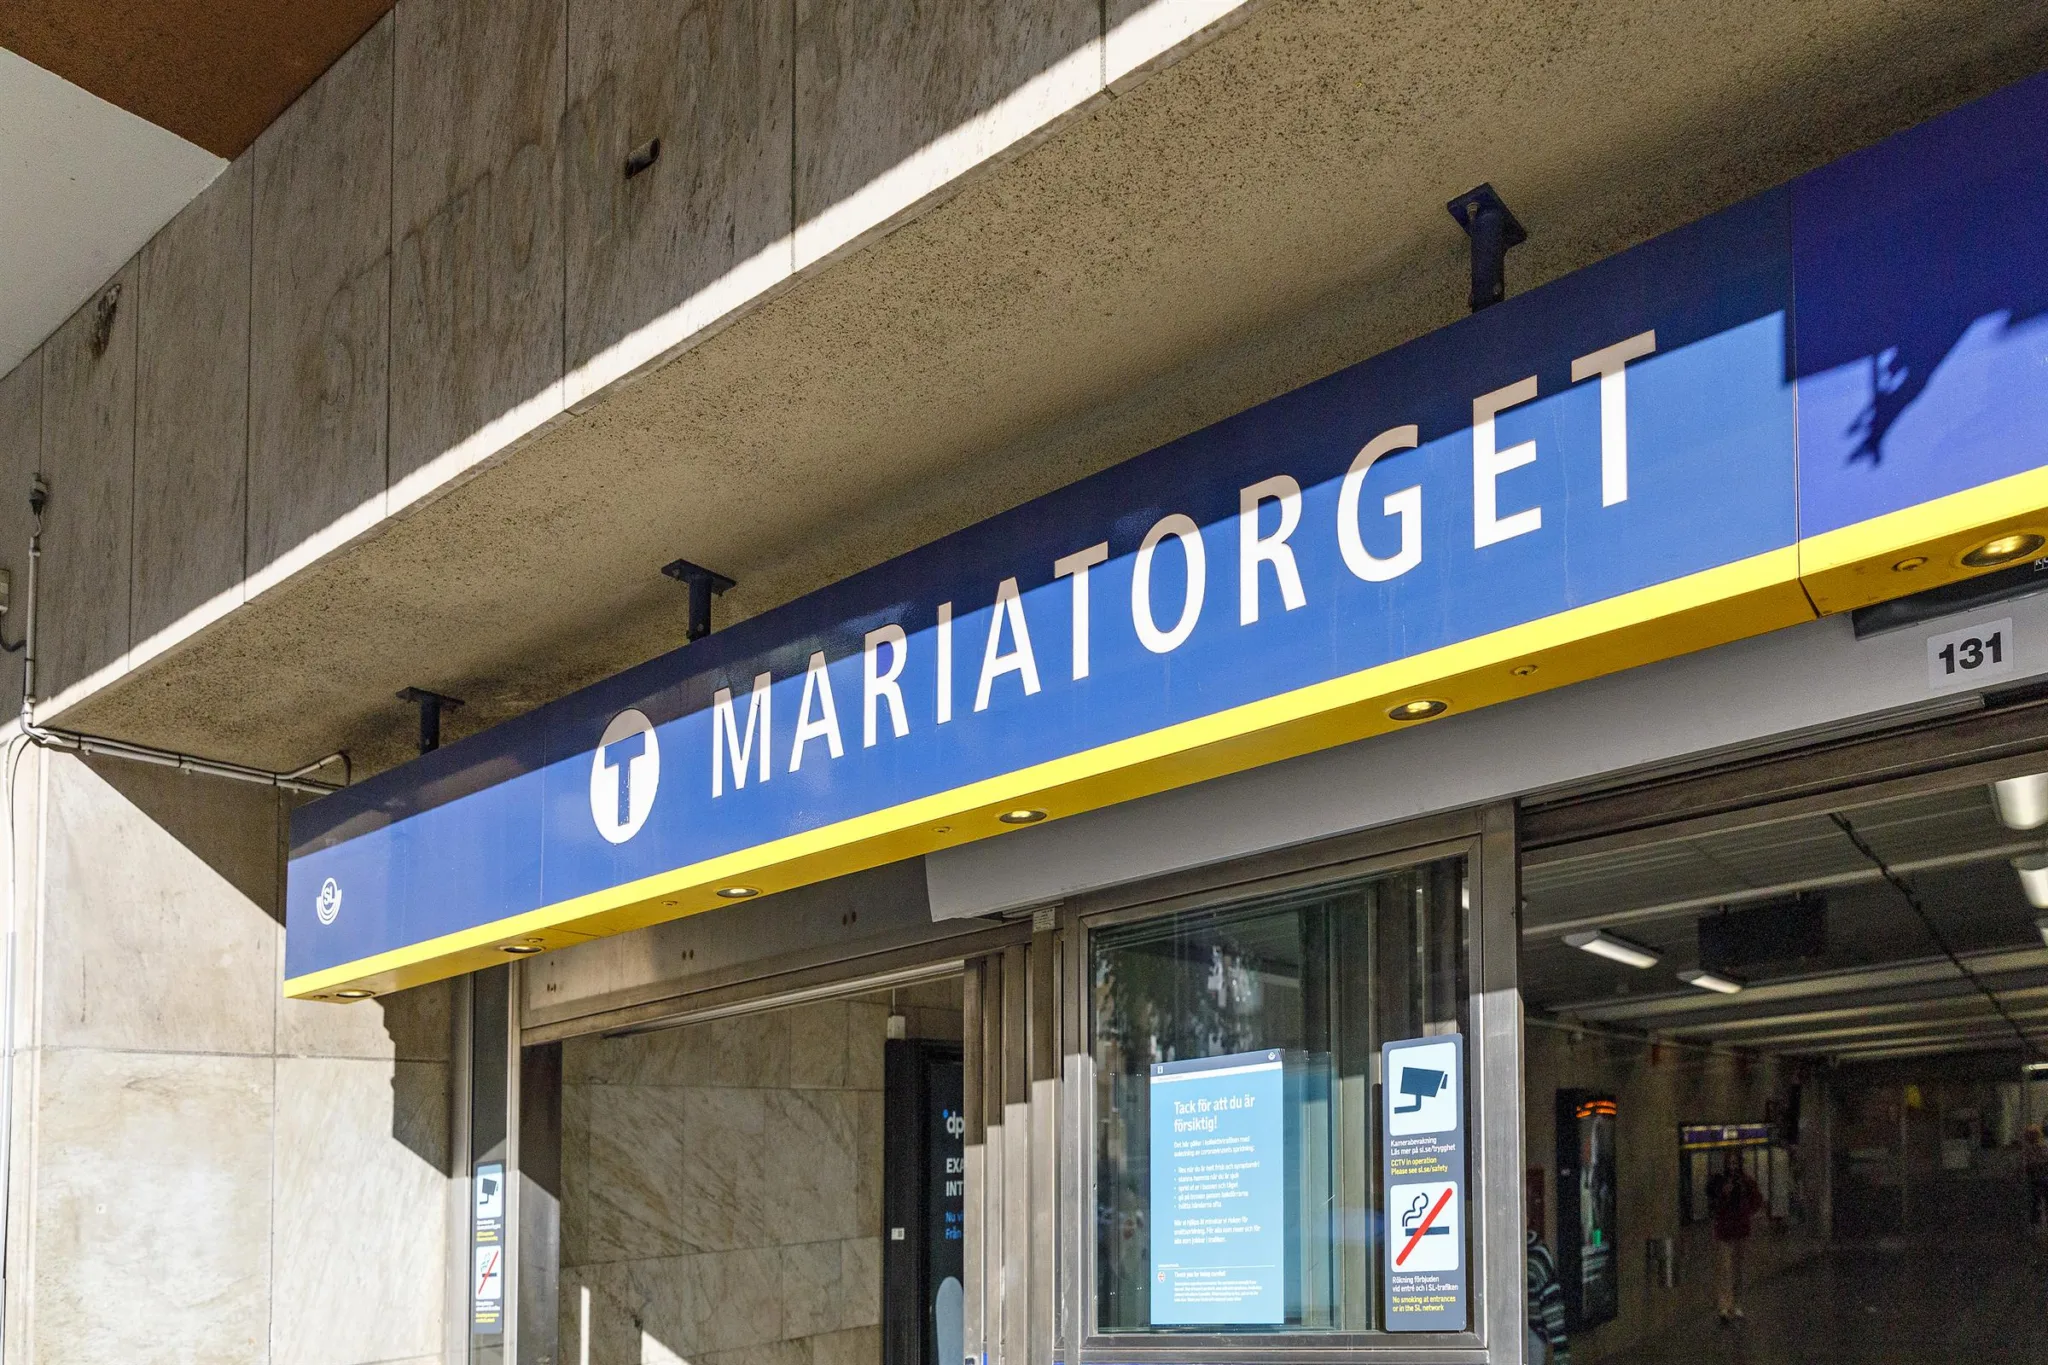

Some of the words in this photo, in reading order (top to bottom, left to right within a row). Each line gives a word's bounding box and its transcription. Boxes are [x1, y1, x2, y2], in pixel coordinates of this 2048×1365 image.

[711, 329, 1656, 799] MARIATORGET
[1938, 631, 2002, 675] 131
[1174, 1100, 1196, 1115] Tack
[1198, 1098, 1211, 1112] för
[1213, 1096, 1228, 1111] att
[1230, 1095, 1242, 1109] du
[1244, 1094, 1255, 1107] är
[1174, 1115, 1217, 1132] försiktig!
[1391, 1137, 1437, 1147] Kamerabevakning
[1412, 1147, 1418, 1155] på
[1419, 1143, 1456, 1153] sl.se/trygghet
[1391, 1158, 1405, 1167] CCTV
[1412, 1157, 1437, 1166] operation
[1418, 1164, 1448, 1173] sl.se/safety
[946, 1181, 964, 1196] INT
[1392, 1276, 1413, 1284] Rökning
[1414, 1275, 1439, 1284] förbjuden
[1392, 1284, 1400, 1292] vid
[1401, 1284, 1415, 1292] entré
[1428, 1283, 1459, 1291] SL-trafiken
[1401, 1296, 1422, 1304] smoking
[1405, 1304, 1414, 1312] the
